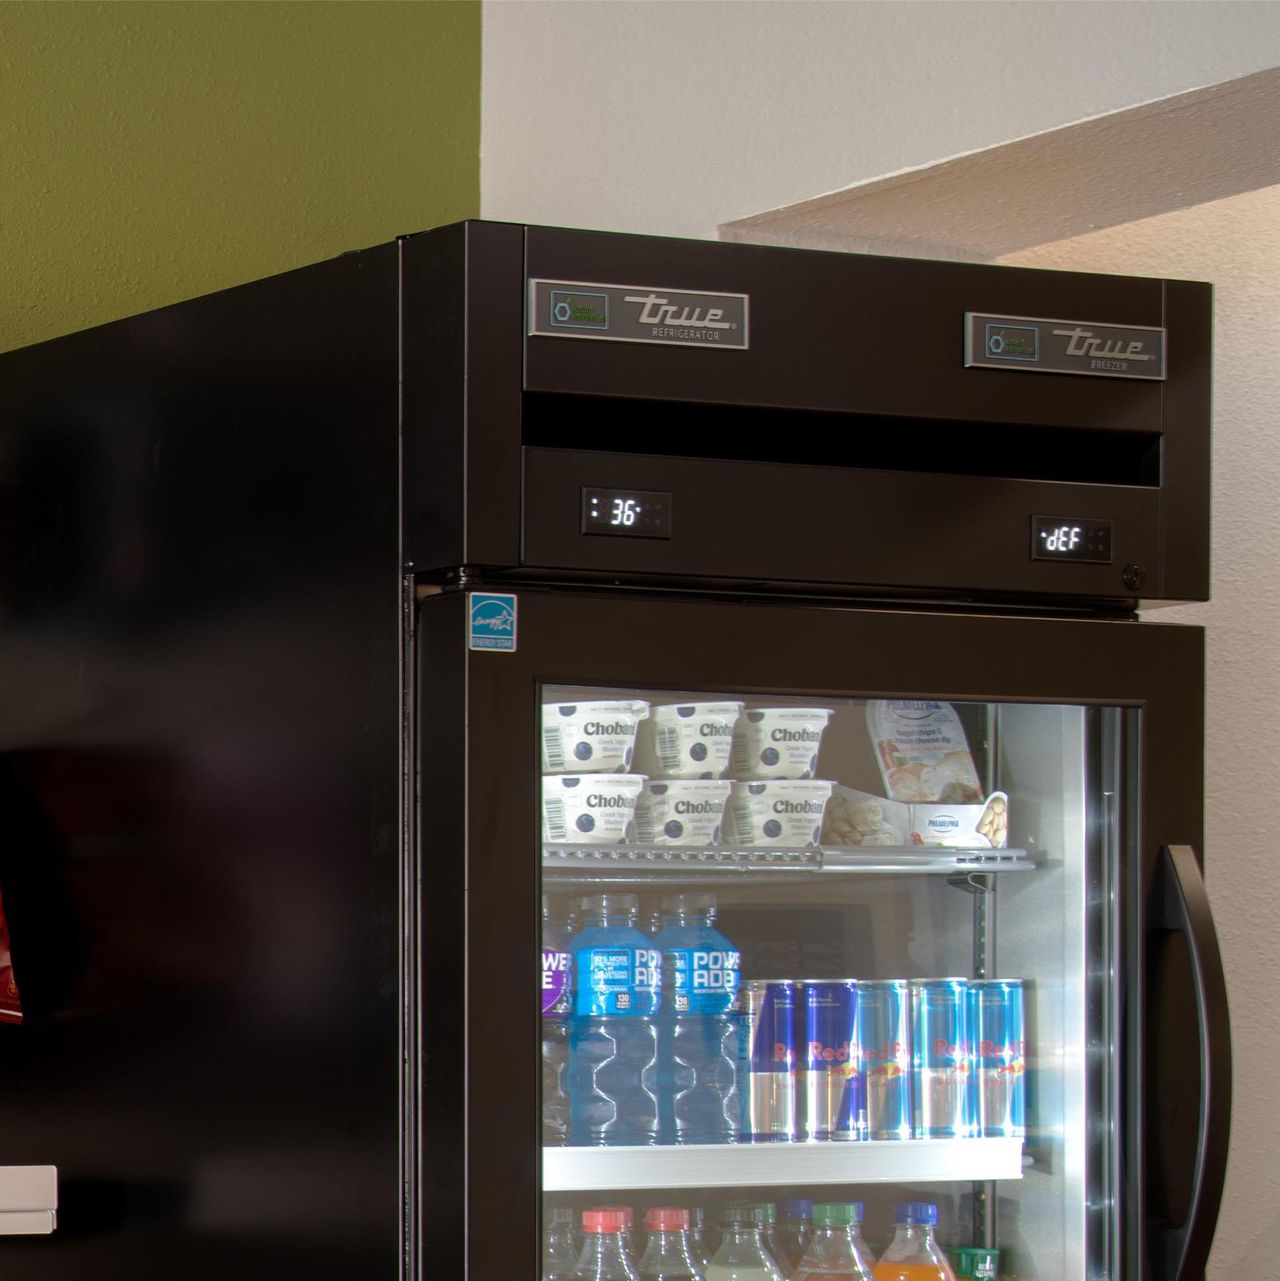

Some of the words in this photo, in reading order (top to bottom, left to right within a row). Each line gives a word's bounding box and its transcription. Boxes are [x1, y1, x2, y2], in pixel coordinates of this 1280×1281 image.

[624, 293, 731, 329] true
[651, 326, 720, 341] REFRIGERATOR
[1053, 328, 1150, 361] true
[1090, 359, 1127, 372] FREEZER
[611, 498, 635, 526] 36
